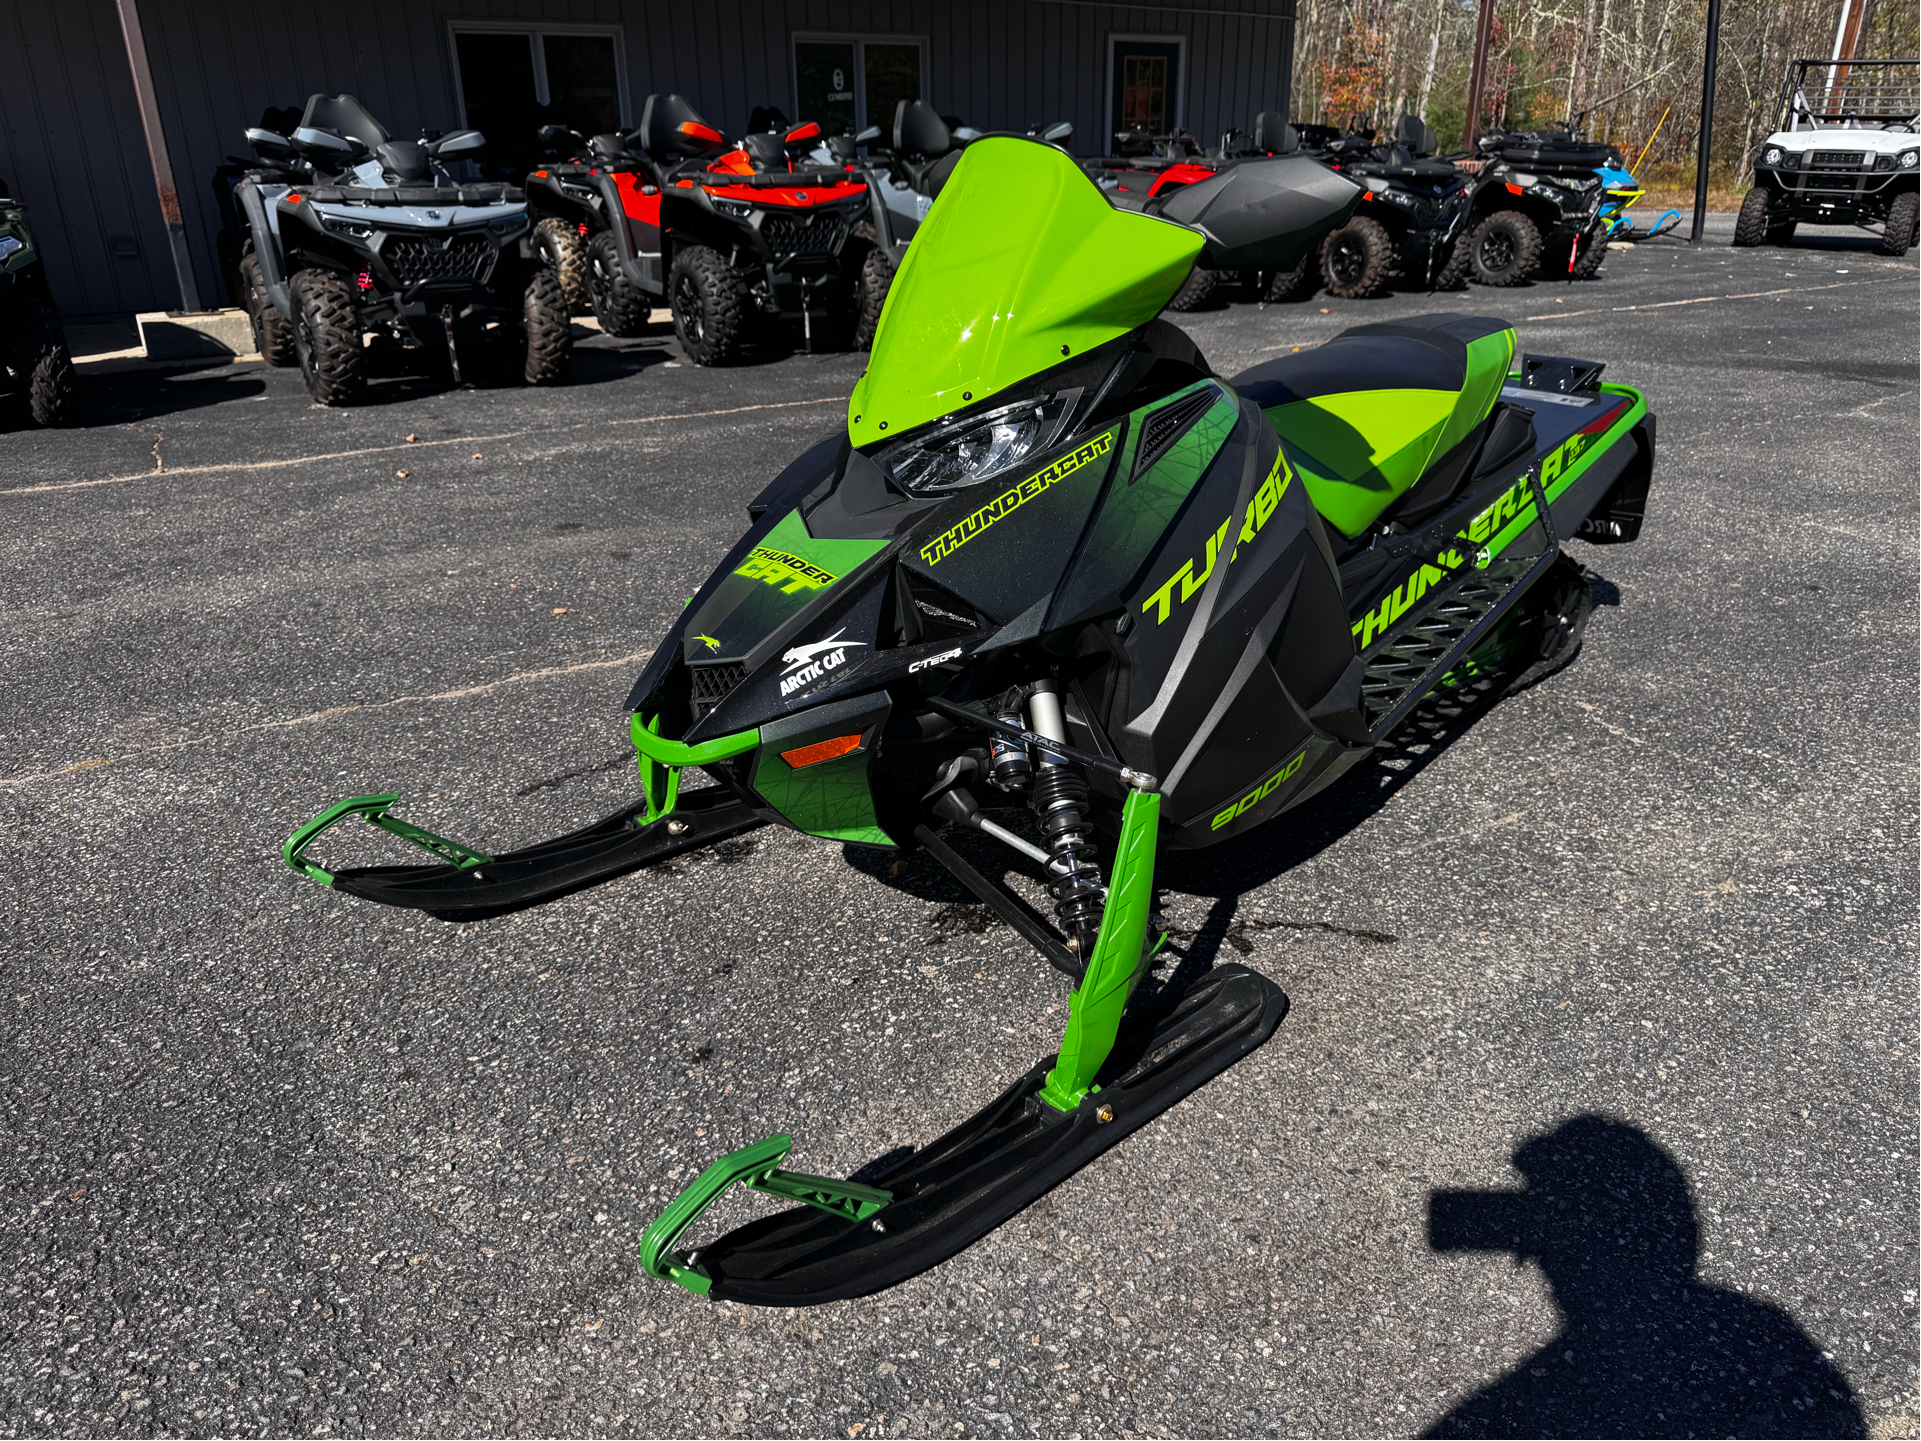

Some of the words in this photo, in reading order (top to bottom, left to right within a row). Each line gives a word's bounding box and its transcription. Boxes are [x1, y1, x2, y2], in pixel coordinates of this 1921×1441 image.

[920, 432, 1112, 566] THUNDERCAT
[734, 558, 821, 595] CAT
[748, 547, 838, 586] THUNDER
[779, 660, 825, 697] ARCTIC
[823, 648, 847, 671] CAT
[1022, 731, 1060, 752] ATAC
[1211, 750, 1306, 831] 9000
